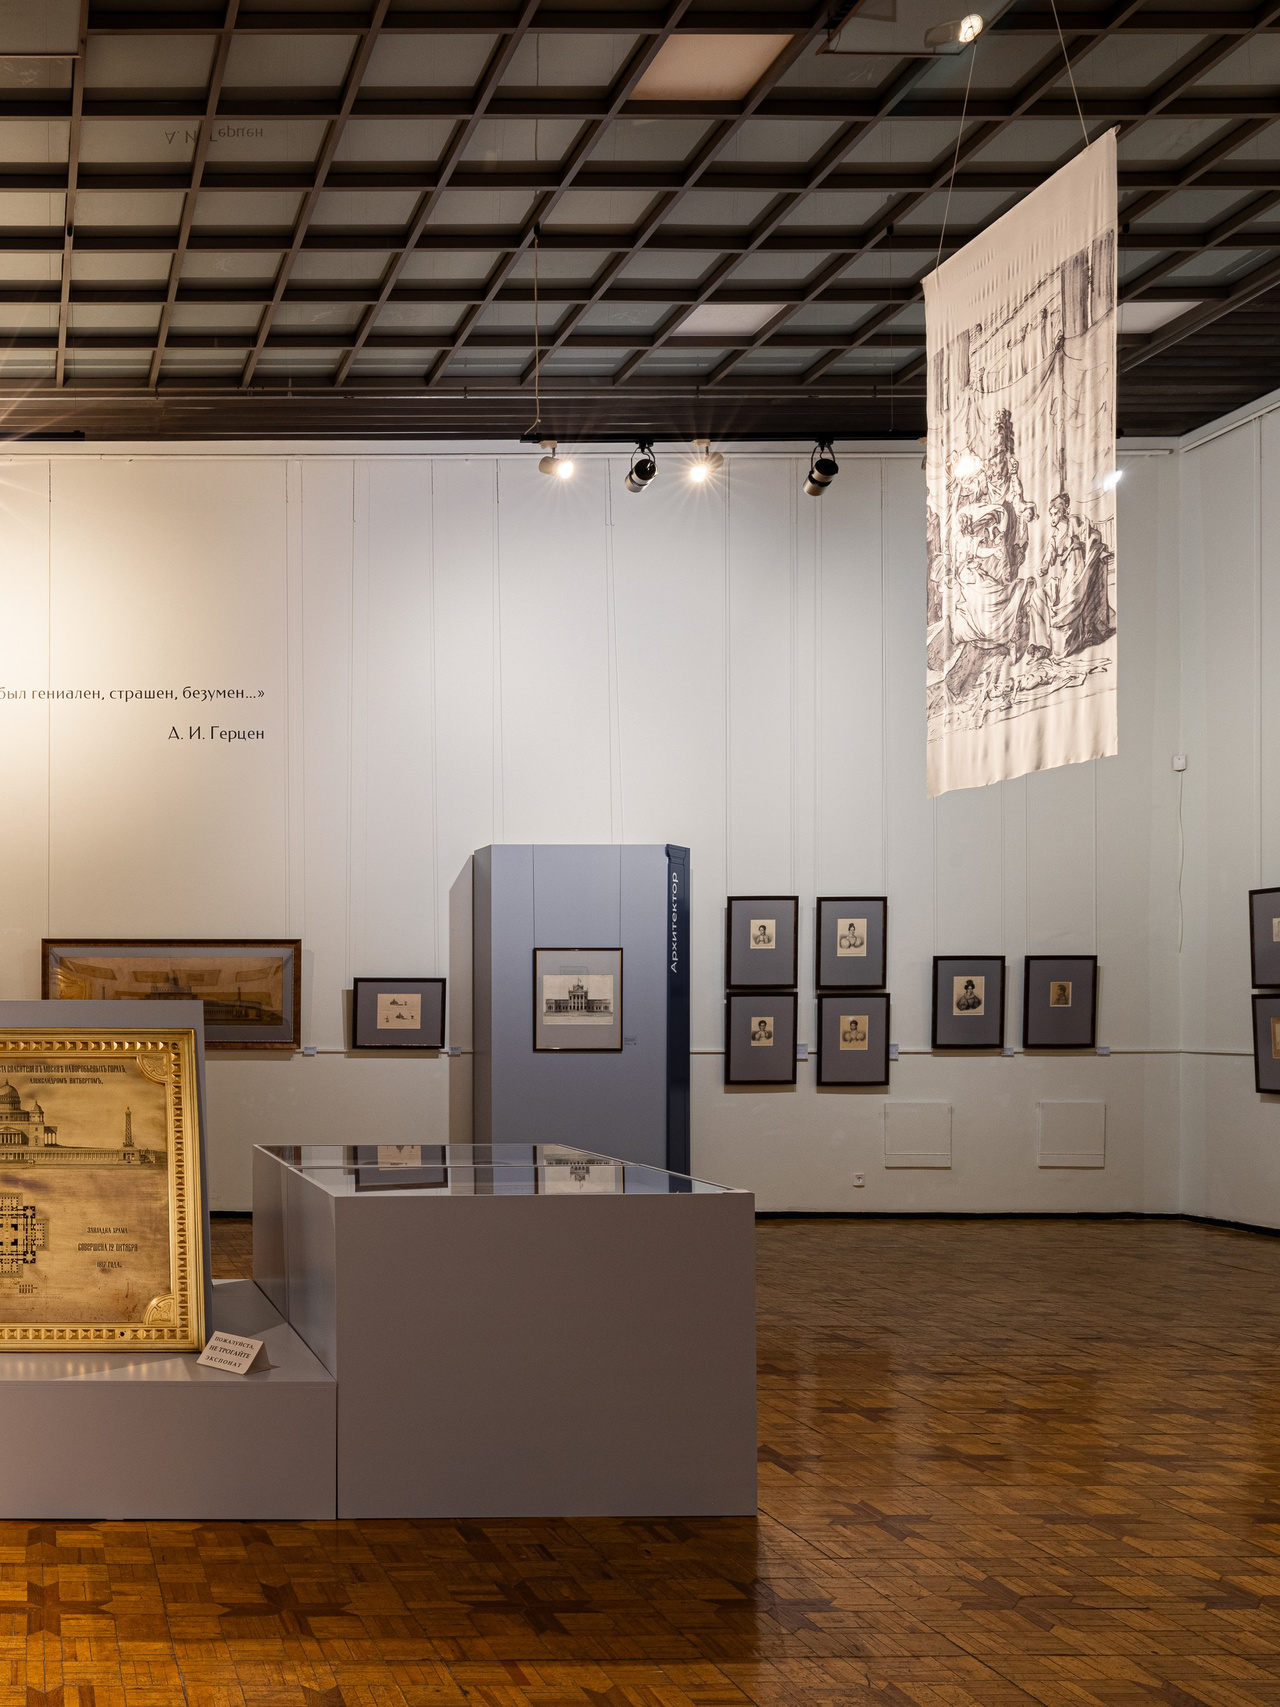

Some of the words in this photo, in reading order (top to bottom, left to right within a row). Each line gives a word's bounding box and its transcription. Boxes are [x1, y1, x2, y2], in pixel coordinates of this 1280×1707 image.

[31, 687, 105, 701] гениален,
[109, 688, 178, 702] страшен,
[168, 726, 184, 740] А.
[189, 726, 206, 740] И.
[210, 725, 265, 741] Герцен
[670, 872, 679, 973] Архитектор
[218, 1347, 251, 1359] ТРОГАЙТЕ
[205, 1355, 242, 1368] ЭКСПОНАТ
